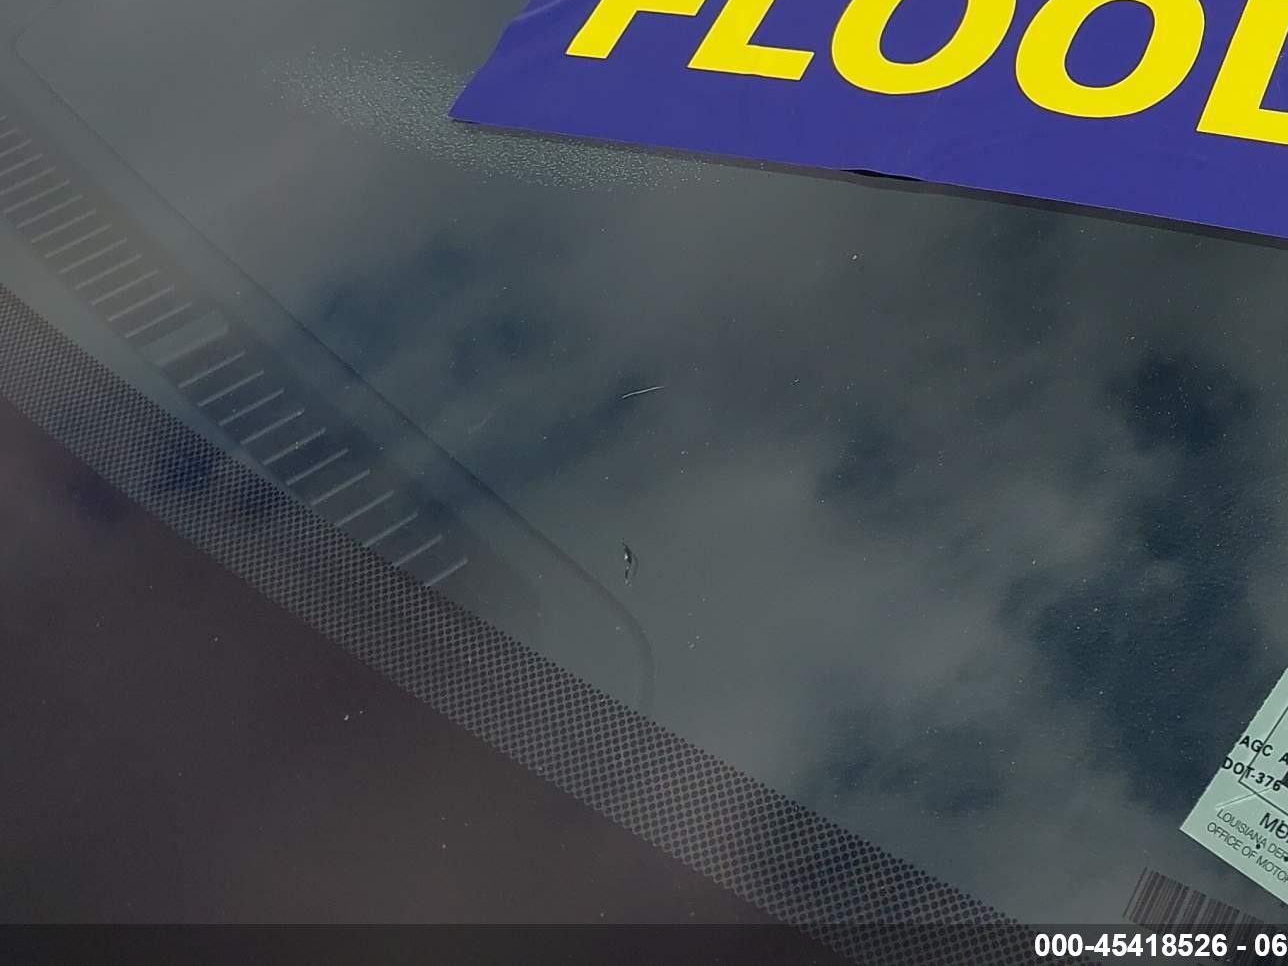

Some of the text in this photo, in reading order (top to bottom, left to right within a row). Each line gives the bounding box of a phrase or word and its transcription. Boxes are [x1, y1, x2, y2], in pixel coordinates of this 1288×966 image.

[1239, 735, 1274, 757] AGC
[1206, 821, 1242, 852] OFFICE
[1216, 808, 1268, 849] LOUISIANA
